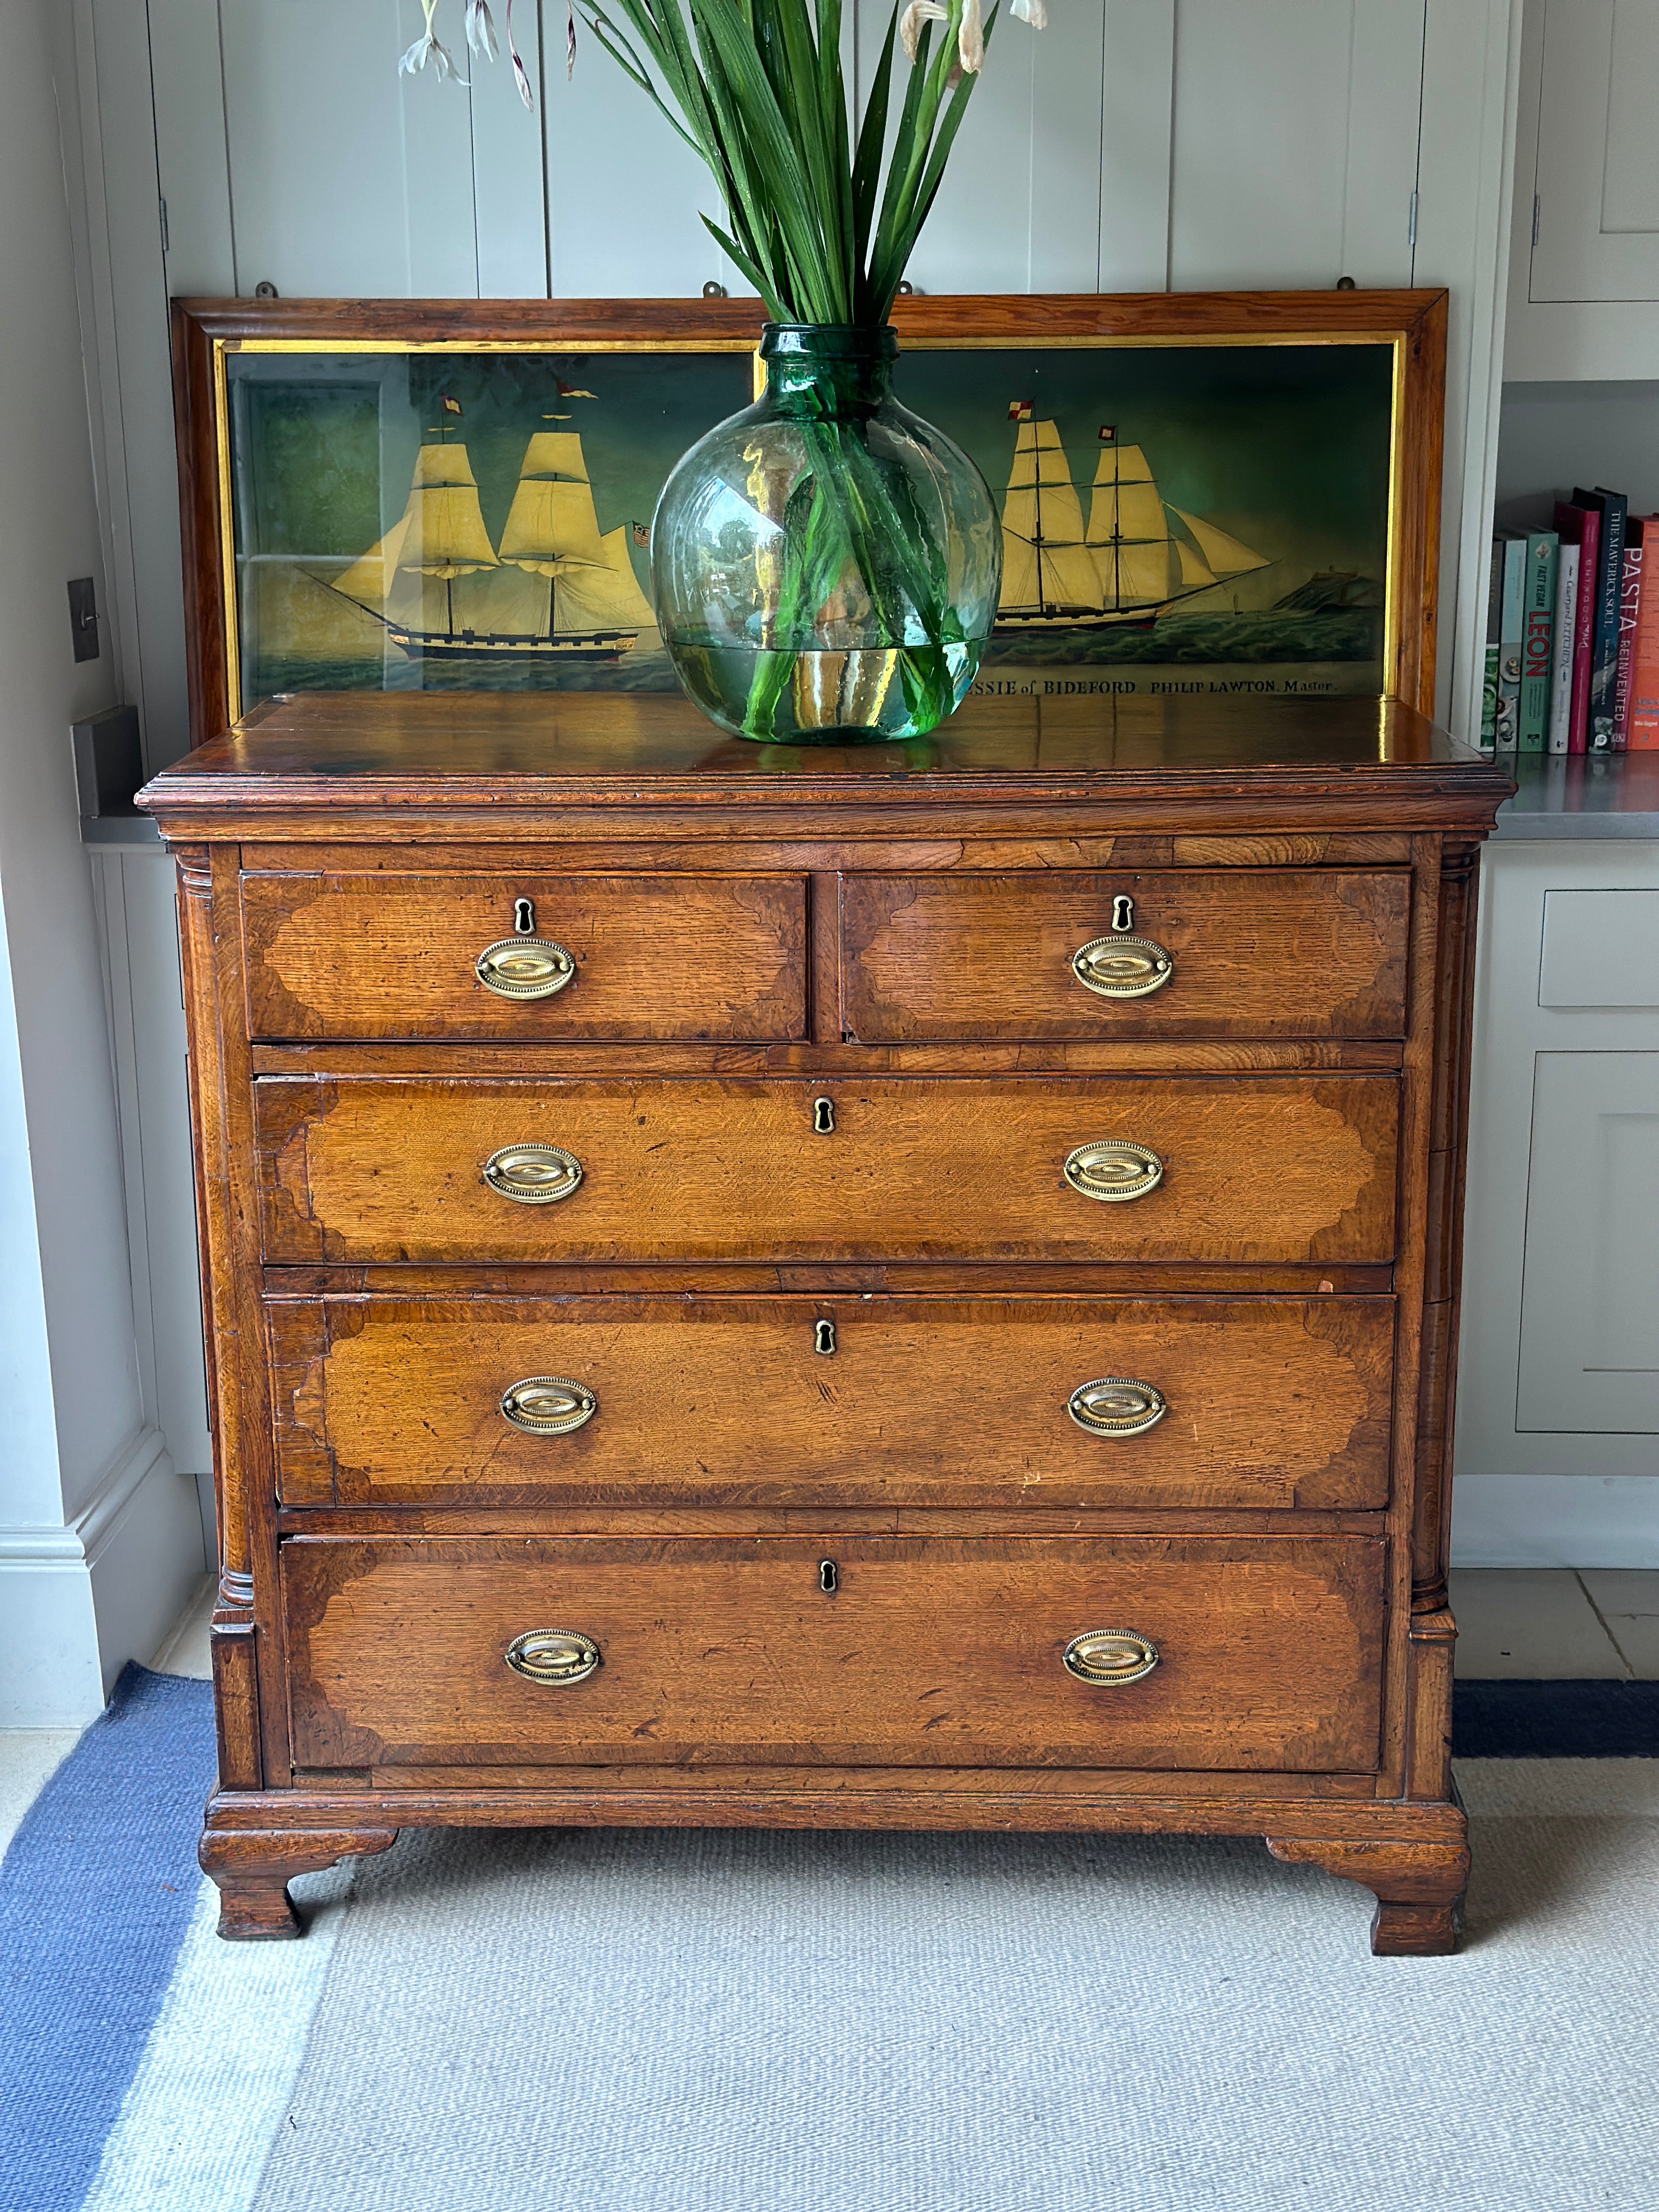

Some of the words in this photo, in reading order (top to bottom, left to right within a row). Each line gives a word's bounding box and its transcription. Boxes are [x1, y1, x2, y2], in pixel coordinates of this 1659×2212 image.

[1610, 511, 1621, 534] THE
[1537, 565, 1548, 582] FAST
[1605, 538, 1618, 596] MAVERICK
[1536, 584, 1547, 607] VEGAN
[1618, 548, 1643, 631] PASTA
[1603, 598, 1615, 627] SOUL
[1525, 611, 1551, 677] LEON
[1021, 680, 1036, 694] of
[1043, 681, 1136, 694] BIDEFORD
[1150, 681, 1204, 693] PHILIP
[1614, 640, 1630, 721] REINVENTED
